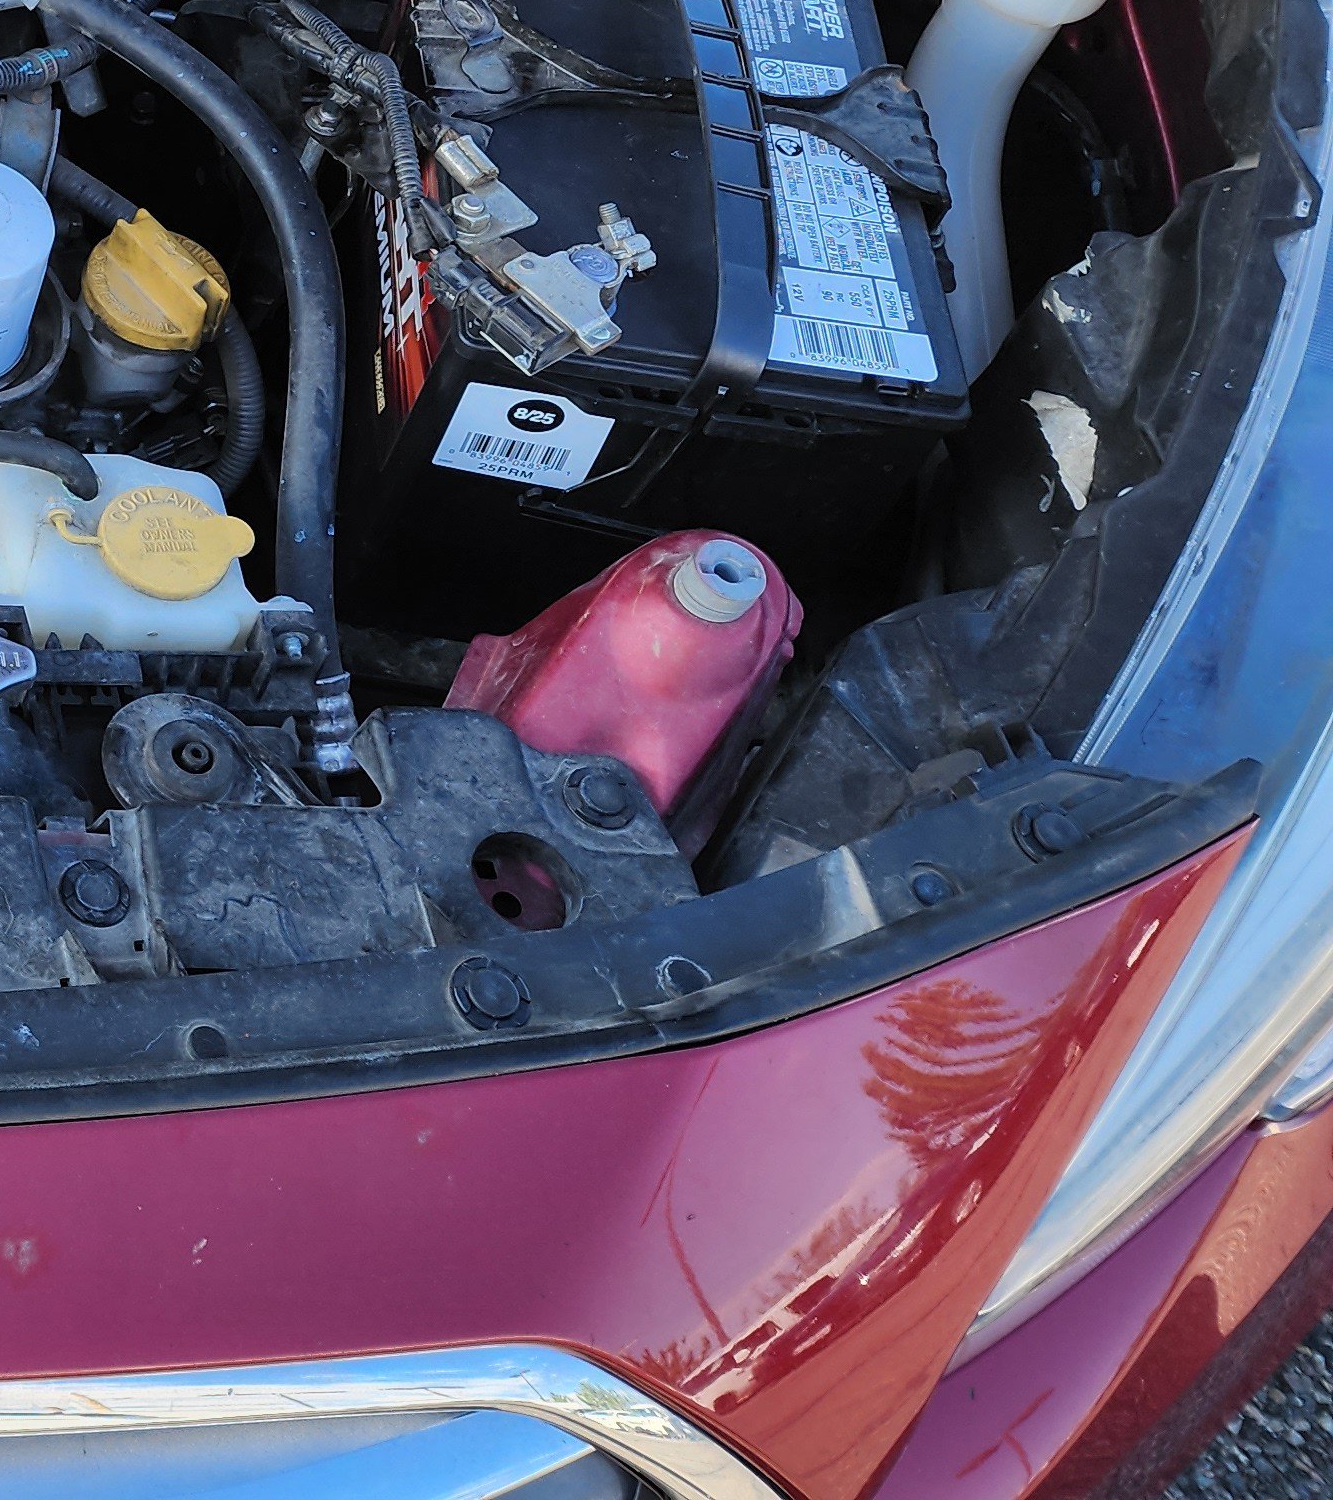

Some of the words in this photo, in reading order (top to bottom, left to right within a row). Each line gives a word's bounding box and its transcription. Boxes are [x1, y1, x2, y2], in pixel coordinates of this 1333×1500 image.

[374, 191, 395, 338] EMIUM
[792, 283, 805, 301] 12V
[849, 292, 862, 307] 550
[900, 291, 913, 308] PART
[883, 290, 899, 319] 25PRM
[513, 407, 557, 425] 8/25
[469, 451, 507, 465] 83996
[511, 460, 551, 472] 04859
[477, 463, 534, 480] 25PRM
[0, 651, 21, 668] 1.1
